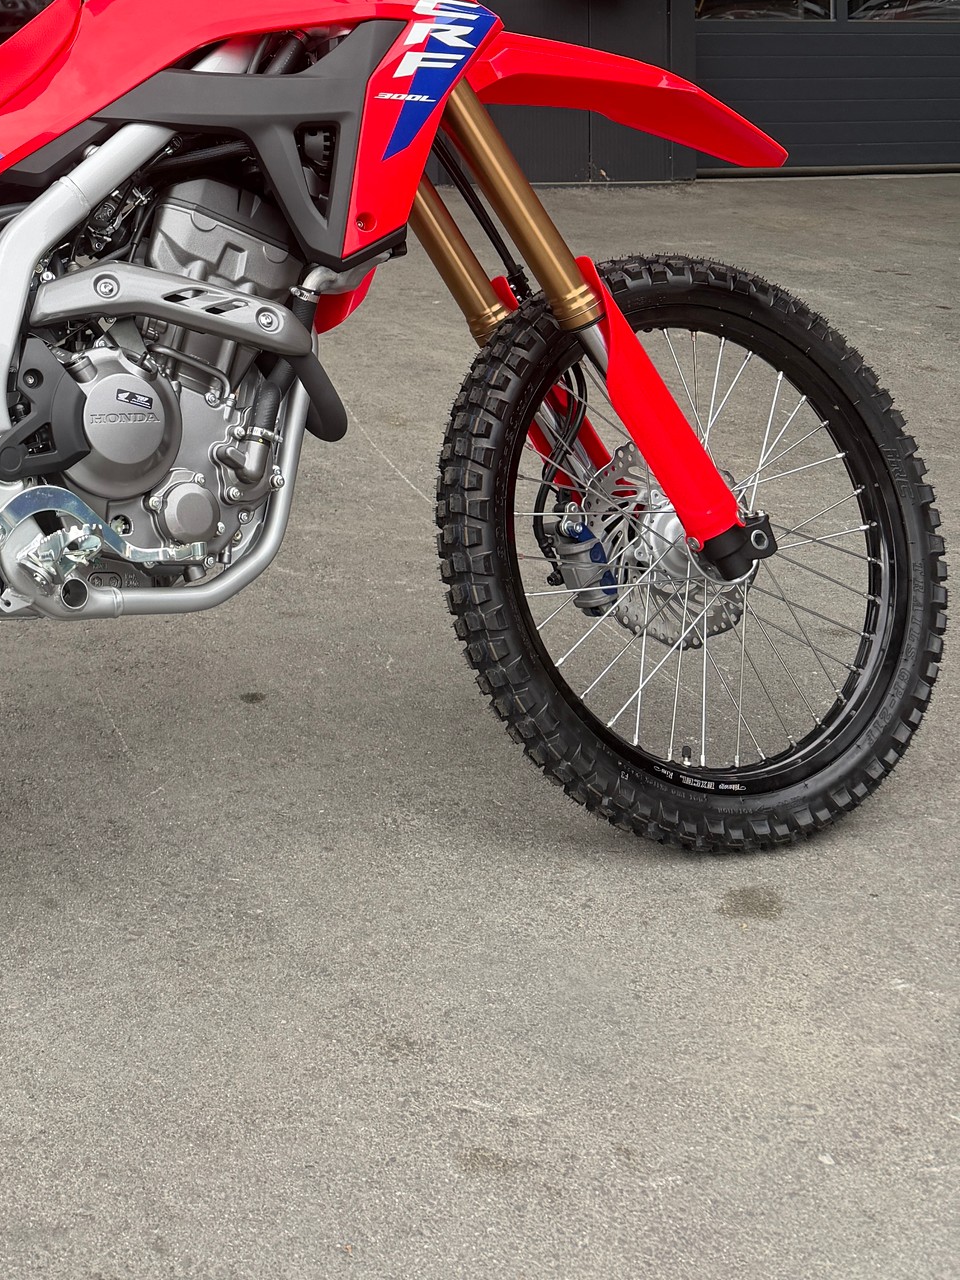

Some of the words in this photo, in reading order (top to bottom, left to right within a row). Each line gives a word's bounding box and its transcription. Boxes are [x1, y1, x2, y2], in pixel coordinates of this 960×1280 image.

[374, 91, 437, 102] 300L
[90, 412, 161, 424] HONDA
[906, 561, 925, 662] TRAILS
